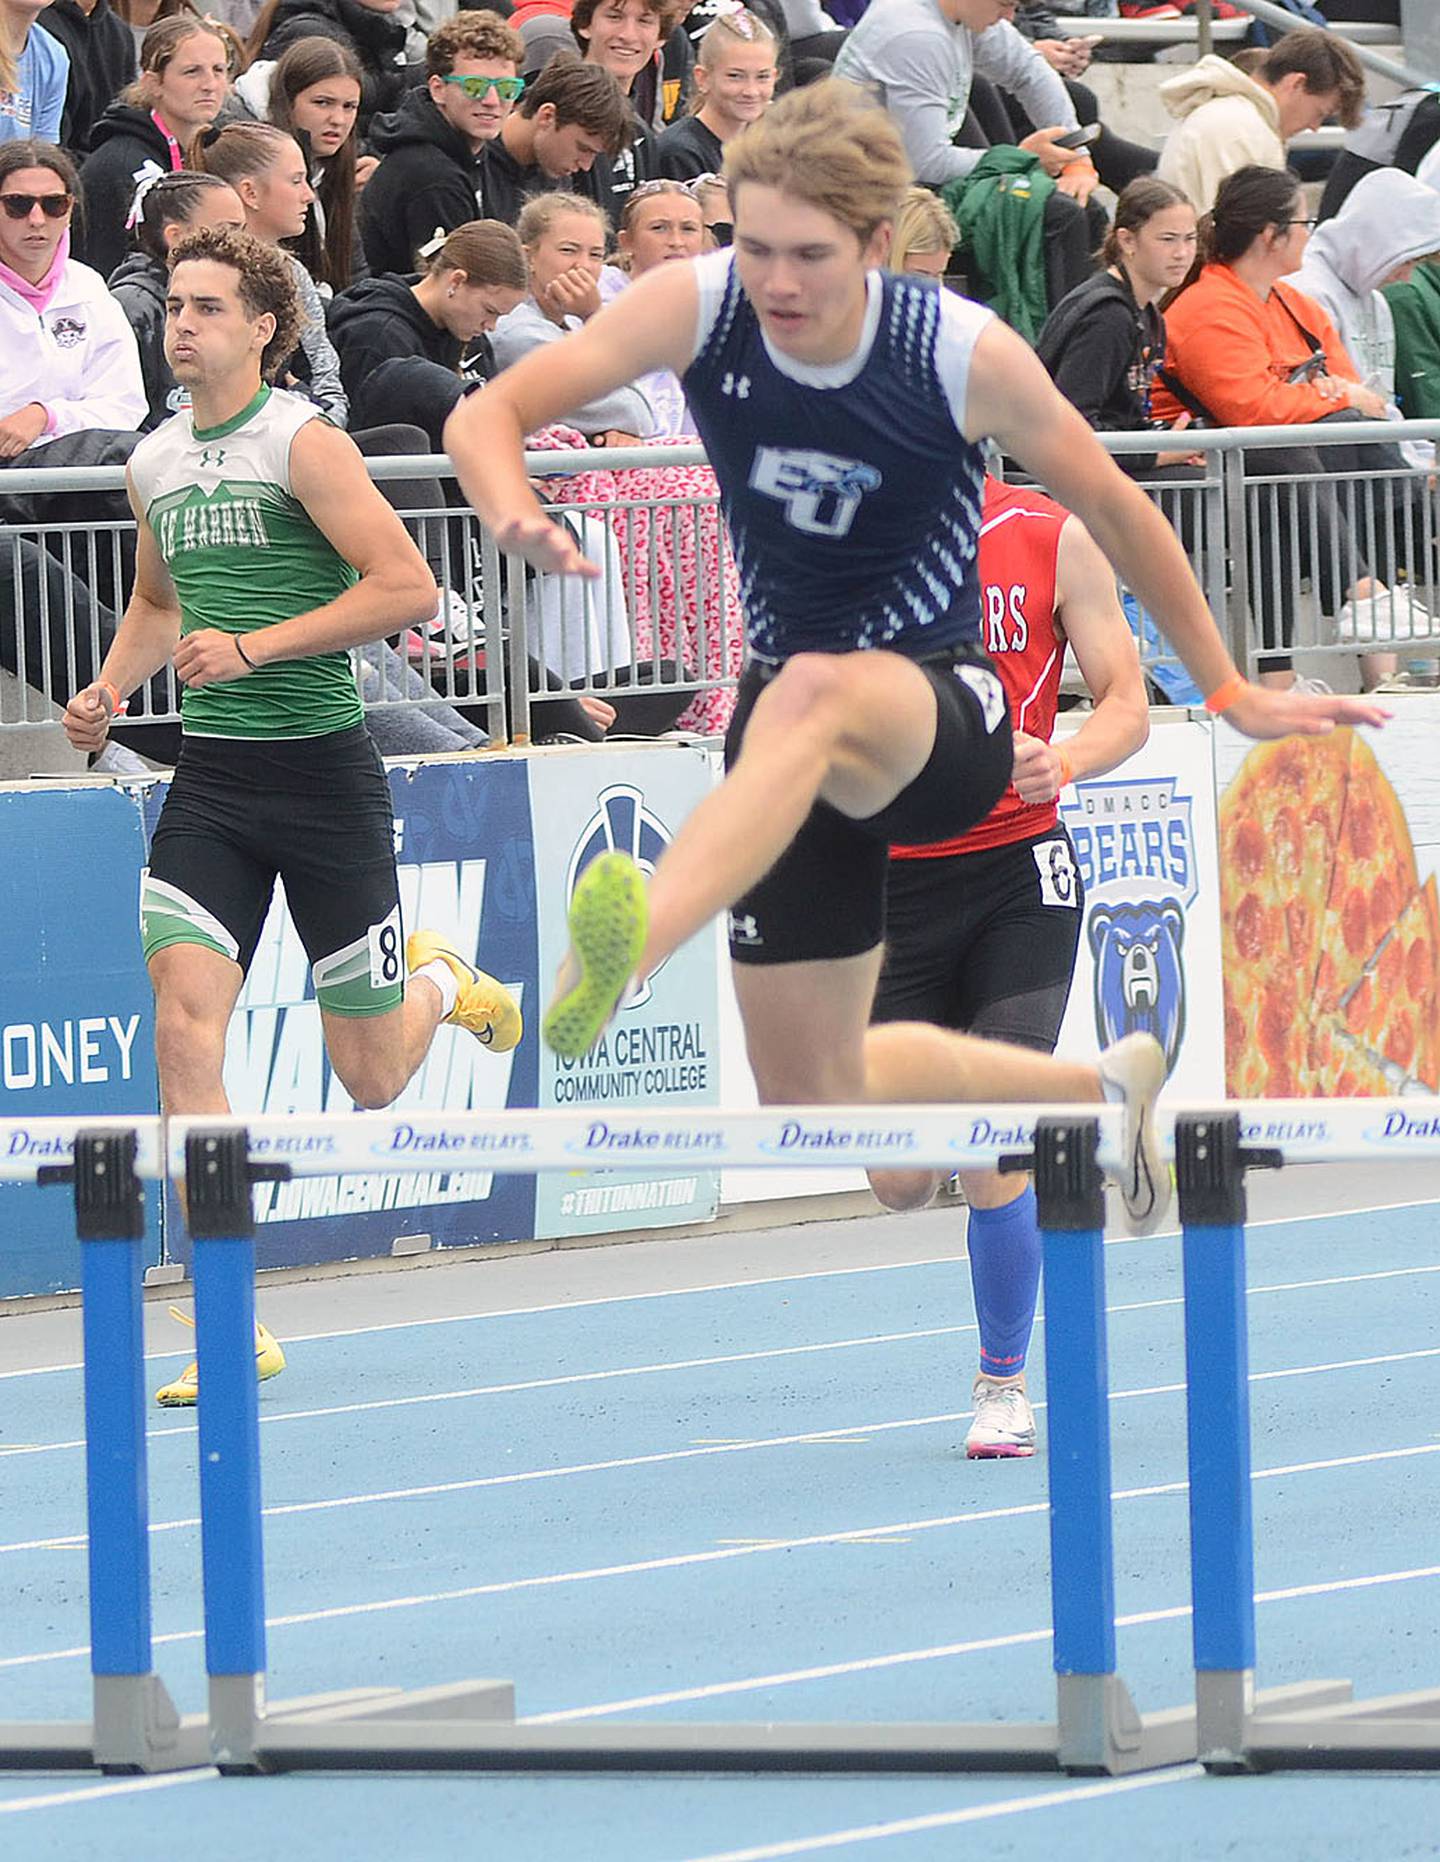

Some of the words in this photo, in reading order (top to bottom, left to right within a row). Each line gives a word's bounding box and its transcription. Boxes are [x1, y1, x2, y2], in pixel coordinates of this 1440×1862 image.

[980, 584, 1029, 653] RS
[1049, 844, 1072, 902] 6
[1072, 819, 1189, 893] BEARS
[379, 925, 398, 981] 8
[3, 1014, 141, 1090] ONEY
[614, 1023, 707, 1067] CENTRAL
[554, 1070, 643, 1103] COMMUNITY
[643, 1064, 707, 1094] COLLEGE
[390, 1122, 466, 1150] Drake
[585, 1120, 660, 1149] Drake
[779, 1119, 852, 1148] Drake
